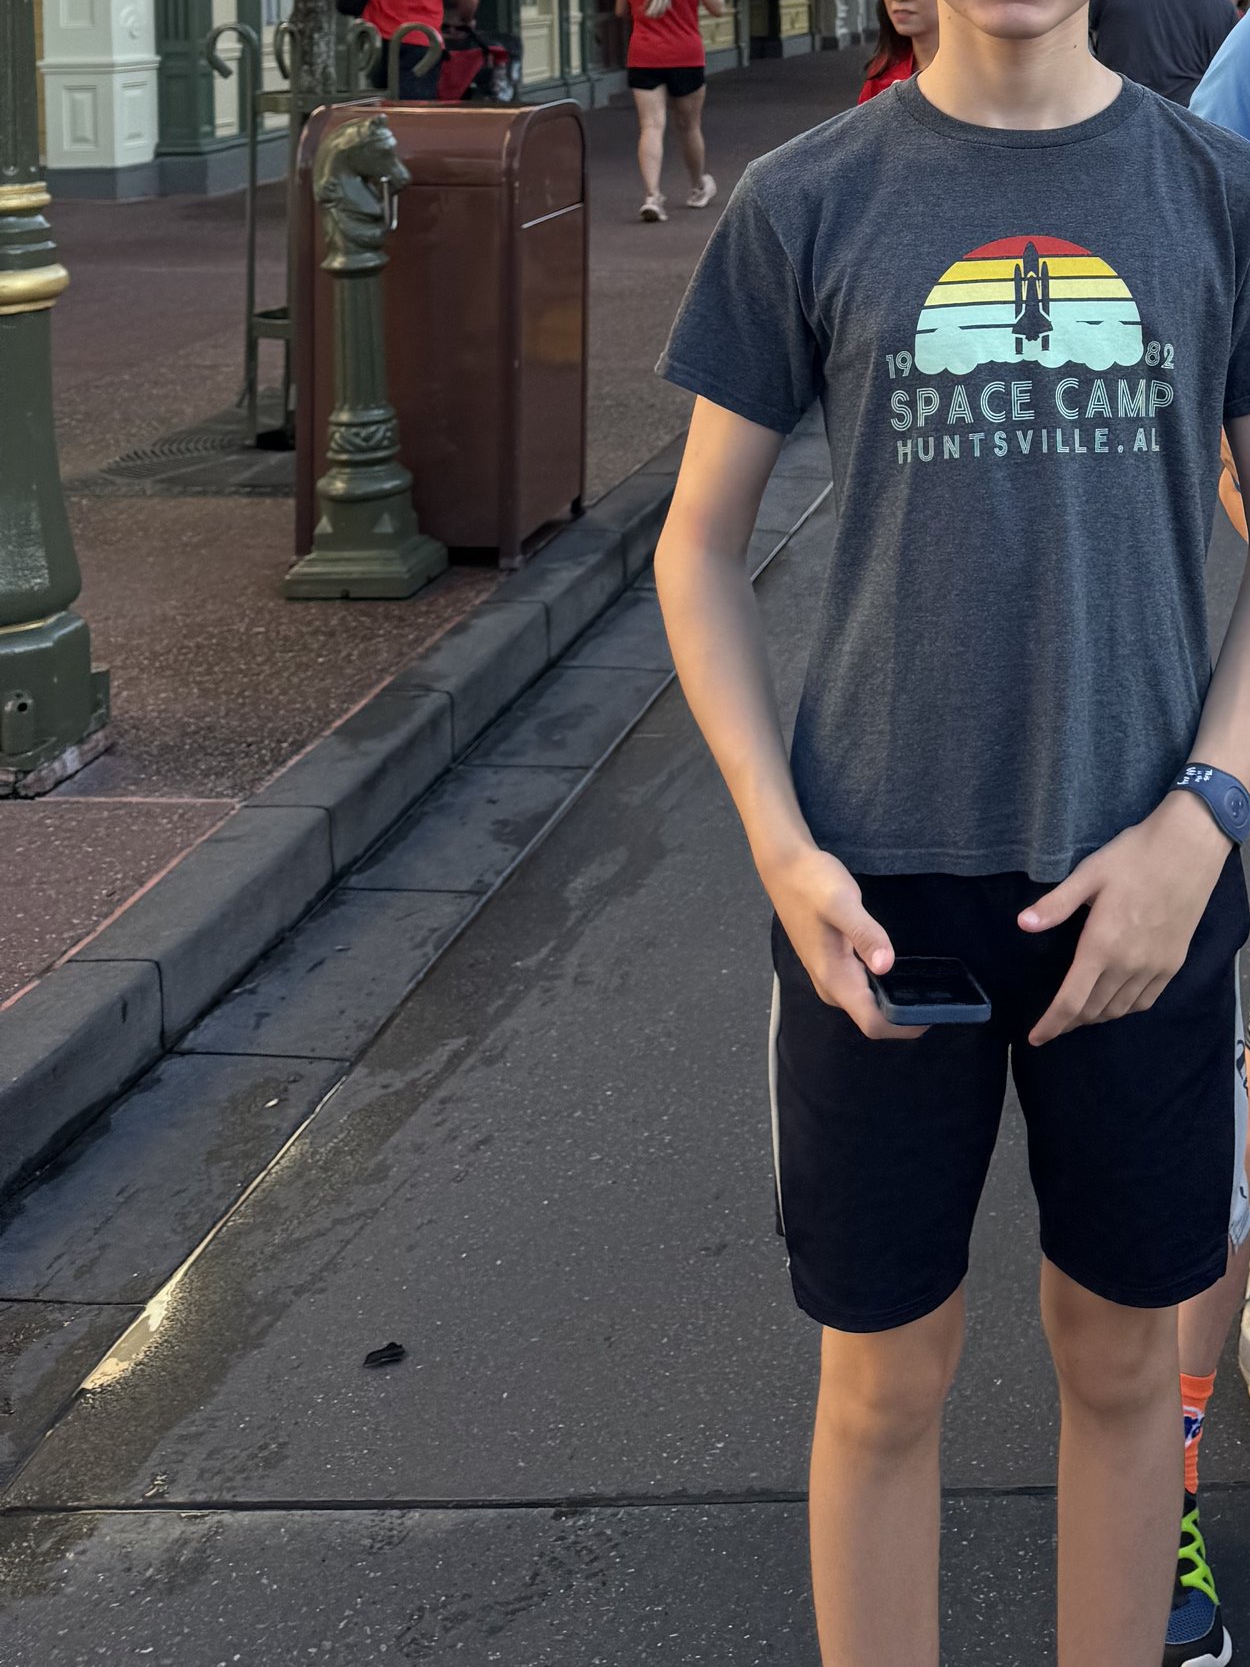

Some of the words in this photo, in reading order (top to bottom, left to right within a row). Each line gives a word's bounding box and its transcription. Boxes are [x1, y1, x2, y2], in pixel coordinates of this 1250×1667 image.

[885, 350, 912, 379] 19
[1144, 341, 1175, 370] 82
[890, 380, 1036, 432] SPACE
[1055, 377, 1174, 420] CAMP
[1133, 427, 1160, 453] AL
